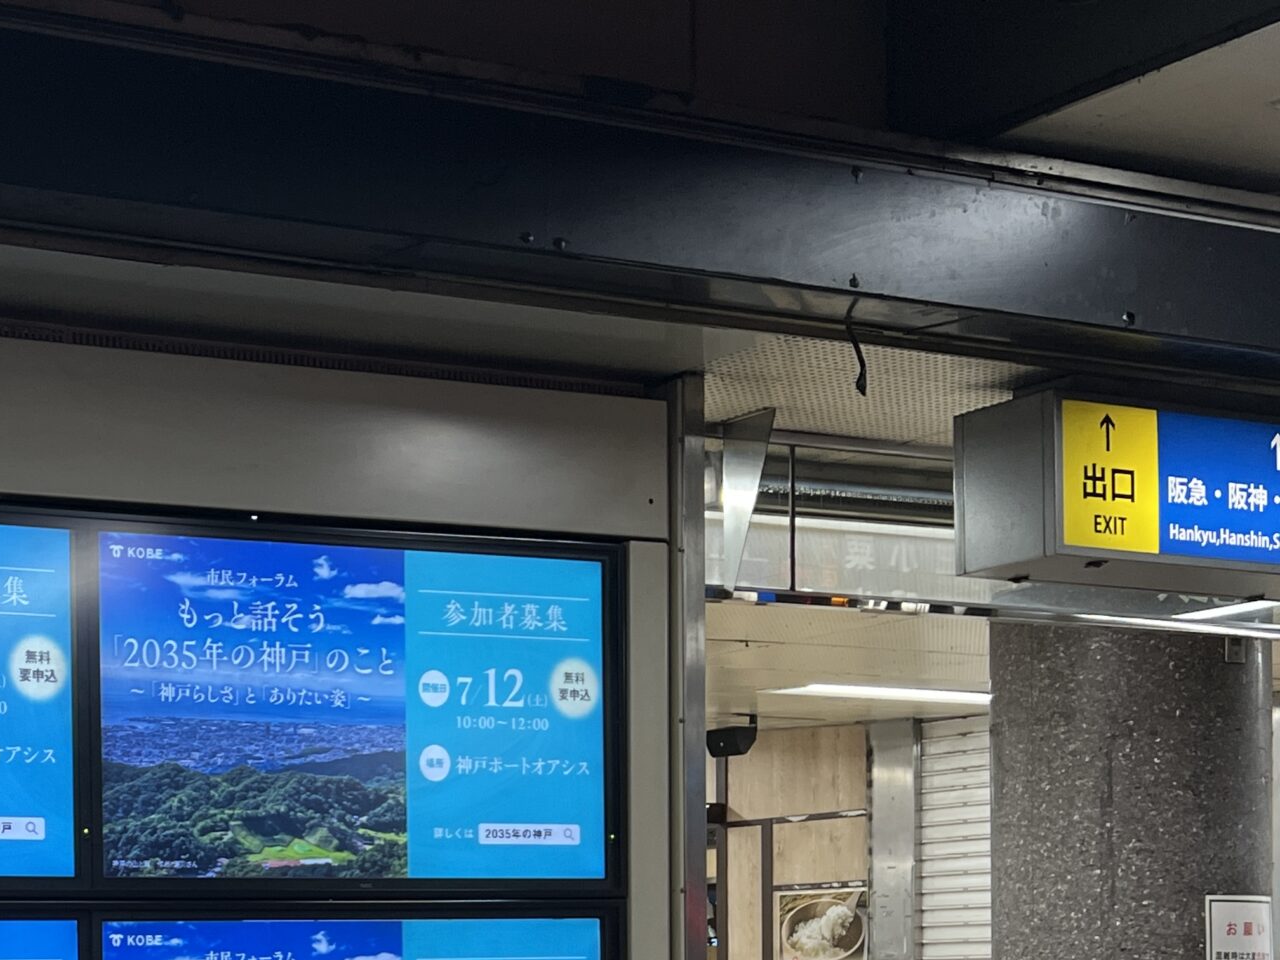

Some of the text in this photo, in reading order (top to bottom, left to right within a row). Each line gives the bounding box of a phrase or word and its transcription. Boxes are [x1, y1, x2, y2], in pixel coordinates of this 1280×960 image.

[1083, 463, 1135, 503] 出口
[1094, 515, 1127, 535] EXIT
[127, 548, 163, 559] KOBE
[206, 569, 298, 588] 市民フォーラム
[178, 598, 324, 632] もっと話そう
[442, 599, 568, 632] 参加者募集
[24, 651, 50, 664] 無料
[113, 635, 395, 675] 「2035年の神戸」のこと
[19, 667, 57, 683] 要申込
[563, 672, 585, 685] 無料
[559, 689, 591, 702] 要申込
[455, 756, 590, 776] 神戸ポートオアシス
[433, 828, 553, 839] 詳しくは 2035年の神戸
[127, 935, 162, 946] KOBE
